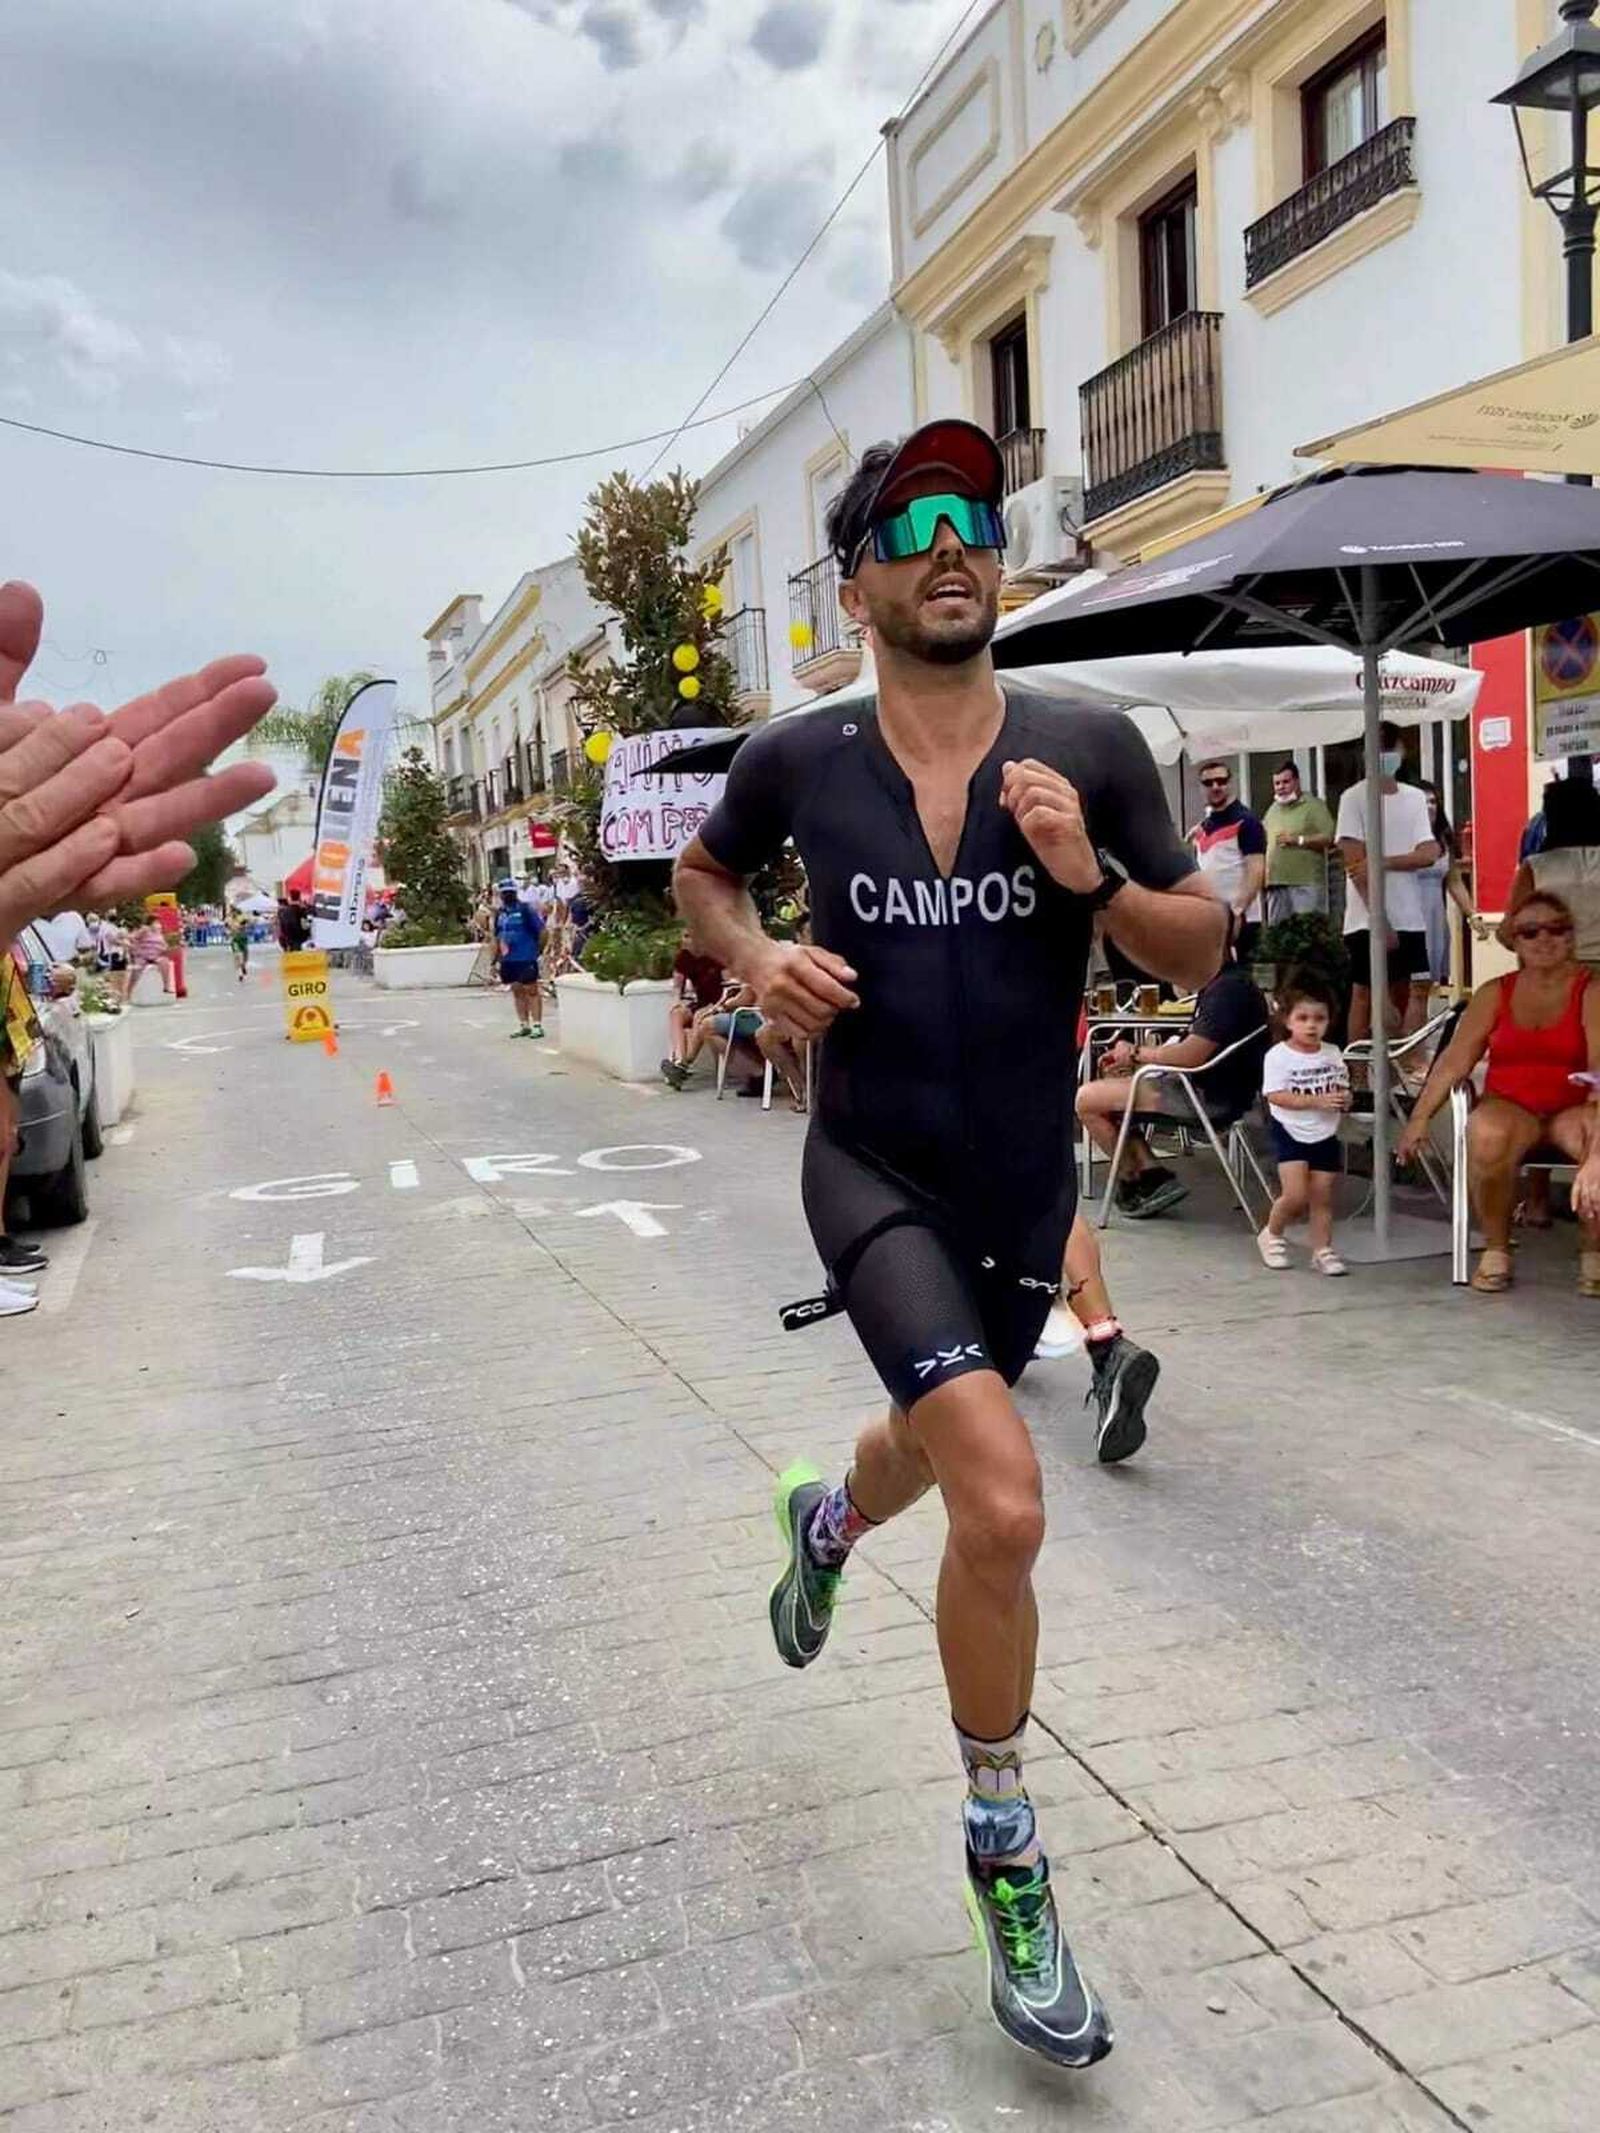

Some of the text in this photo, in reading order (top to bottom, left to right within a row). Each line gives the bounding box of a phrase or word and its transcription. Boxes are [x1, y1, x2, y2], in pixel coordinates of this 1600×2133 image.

[1356, 672, 1456, 694] Cuzcampo
[850, 865, 1036, 926] CAMPOS
[288, 981, 327, 997] GIRO
[229, 1144, 703, 1200] GIRO
